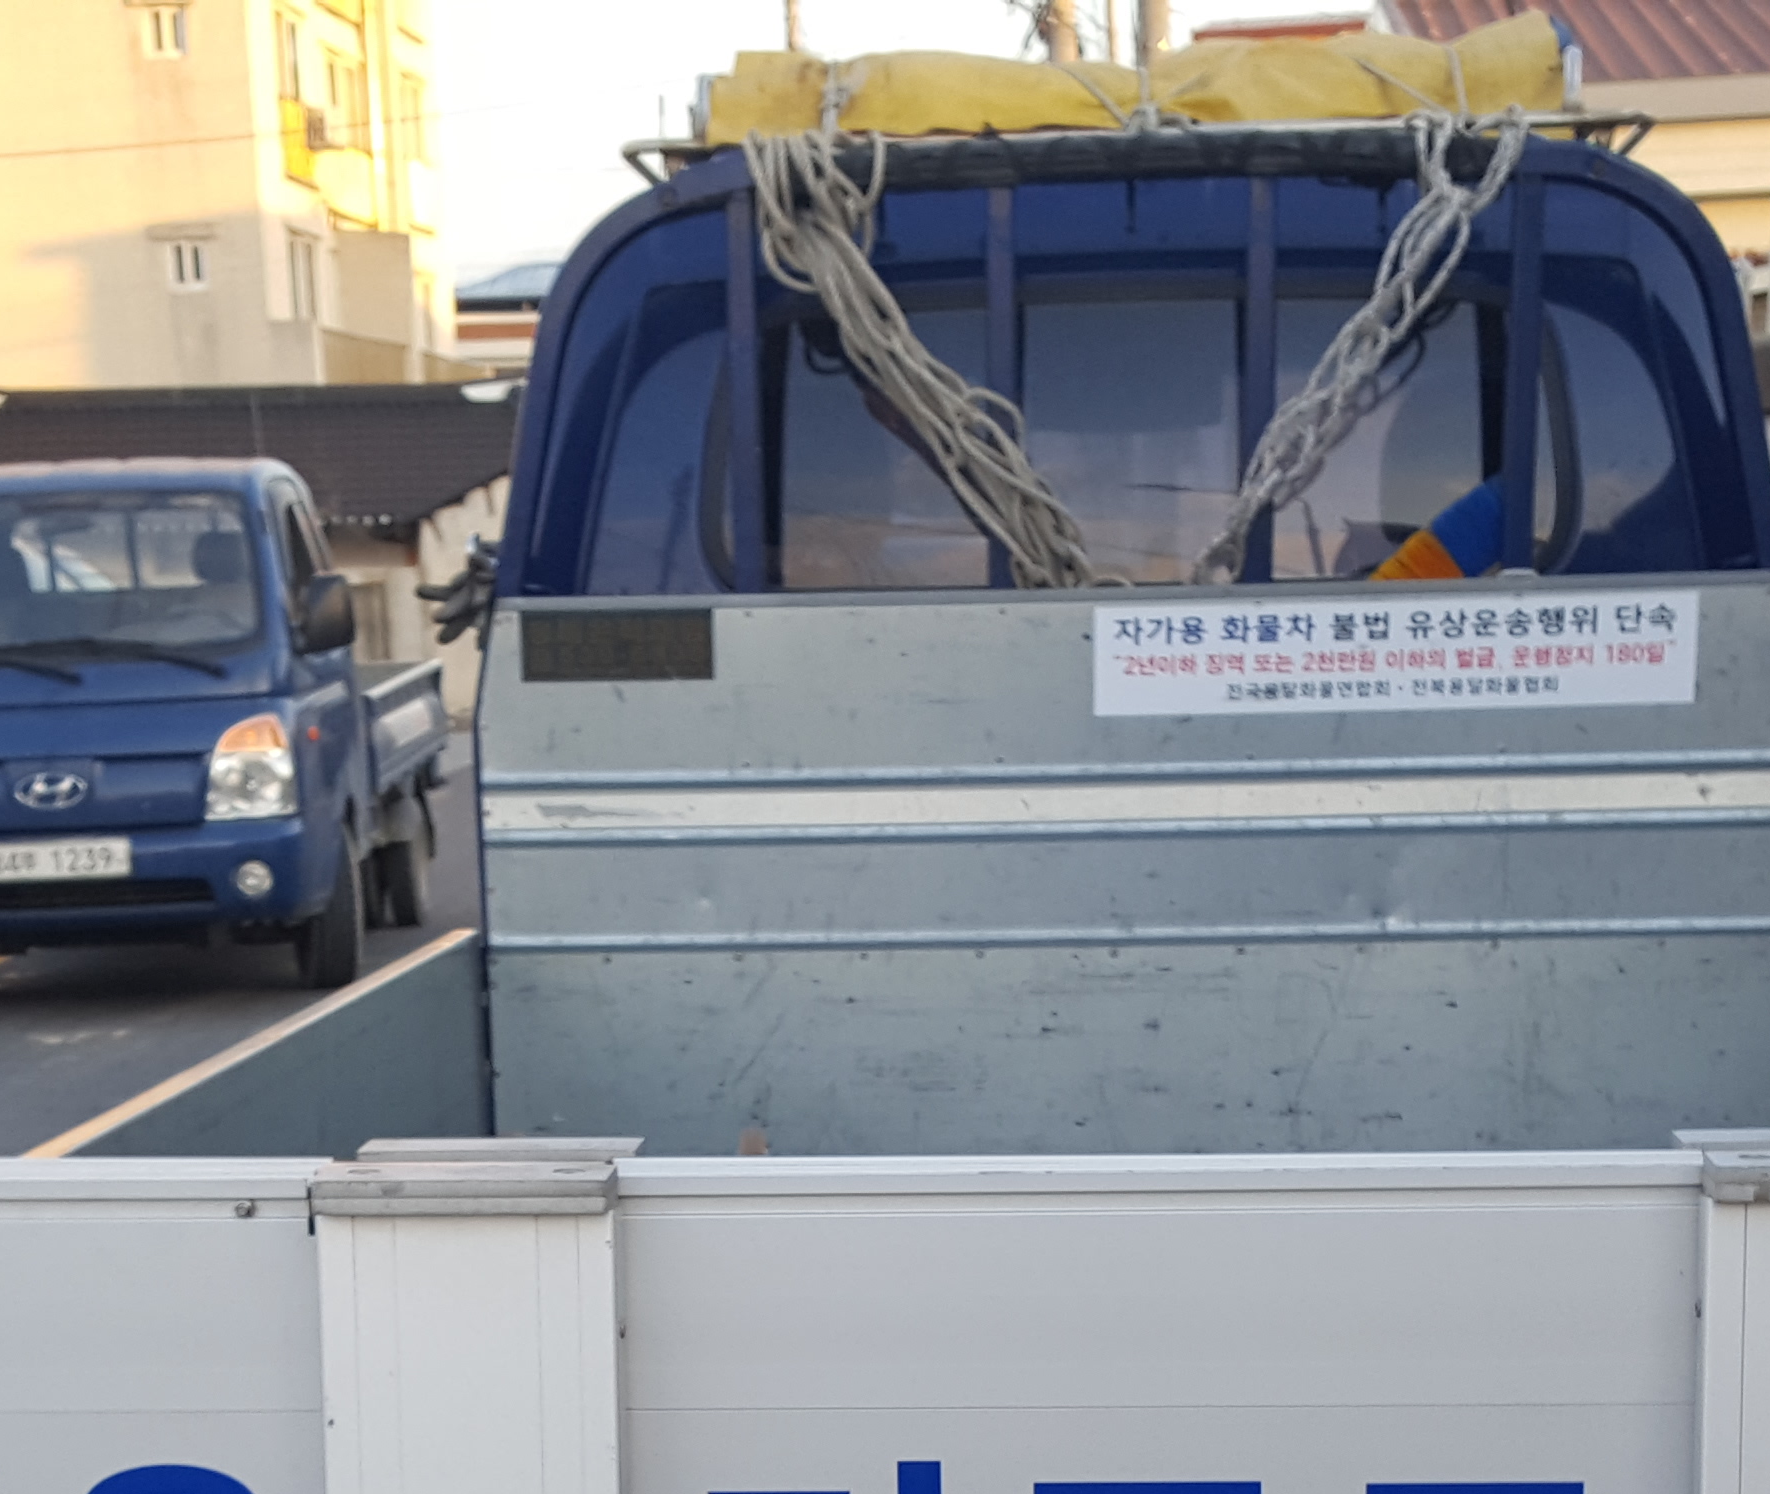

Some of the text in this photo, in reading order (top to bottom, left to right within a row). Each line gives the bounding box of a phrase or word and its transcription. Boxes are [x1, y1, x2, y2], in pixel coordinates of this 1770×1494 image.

[1114, 602, 1676, 645] 자가용 화물차 불법 유상운송행위 단속
[1253, 651, 1294, 674] 또는
